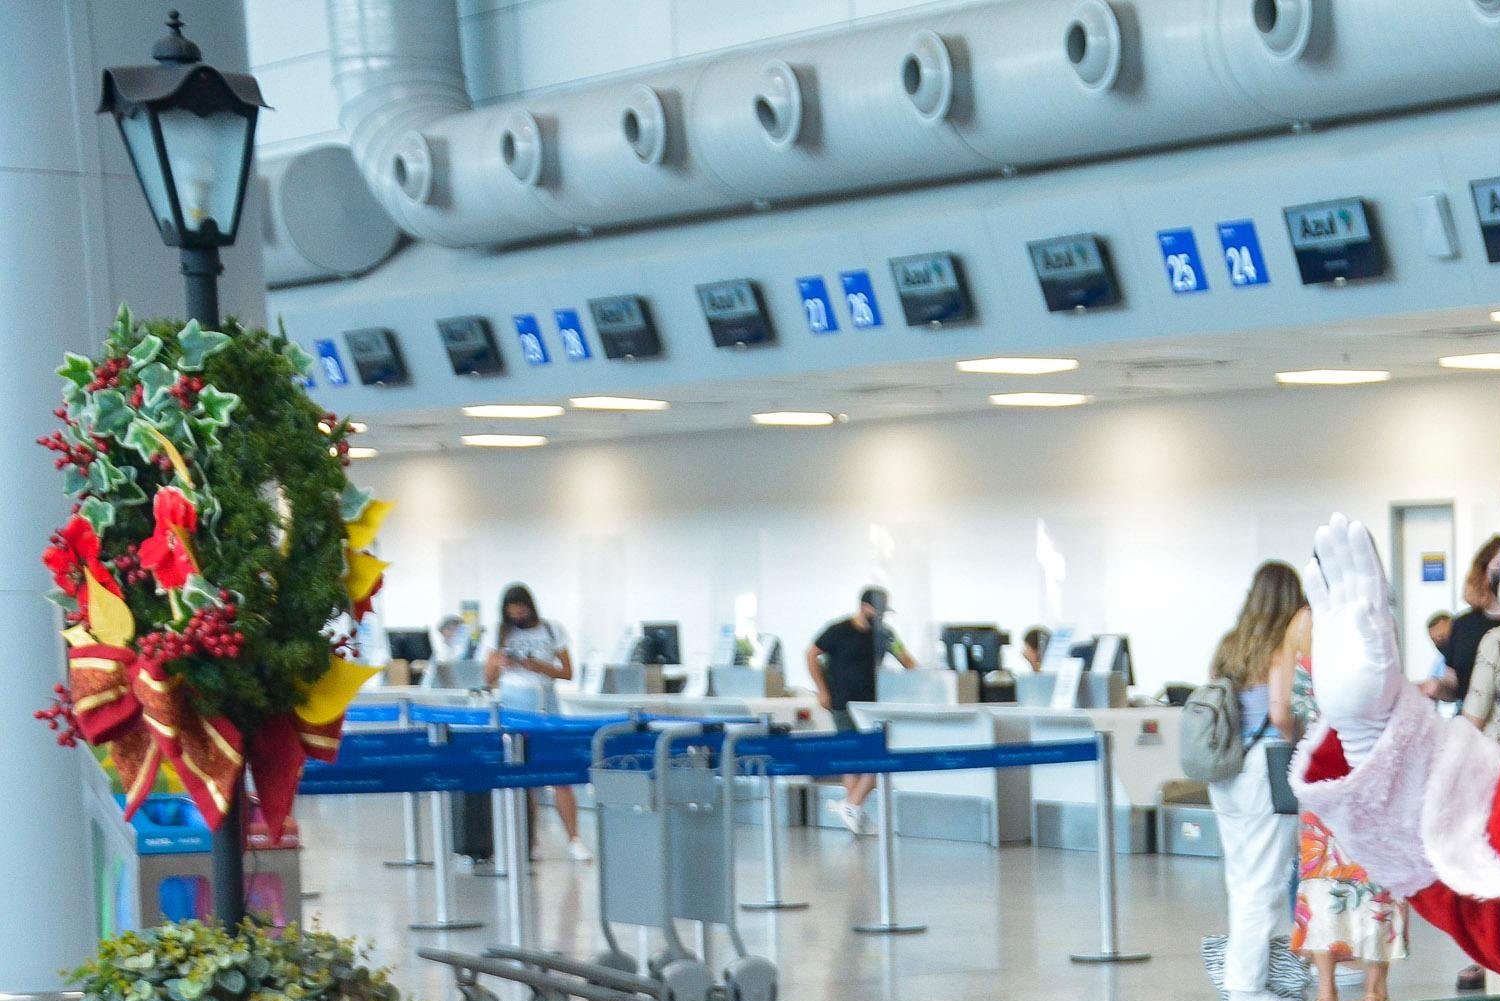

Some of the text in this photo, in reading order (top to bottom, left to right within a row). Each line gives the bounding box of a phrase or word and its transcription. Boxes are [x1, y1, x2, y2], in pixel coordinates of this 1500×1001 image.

[1302, 211, 1337, 237] Azul
[1167, 253, 1197, 291] 25
[1226, 246, 1257, 285] 24
